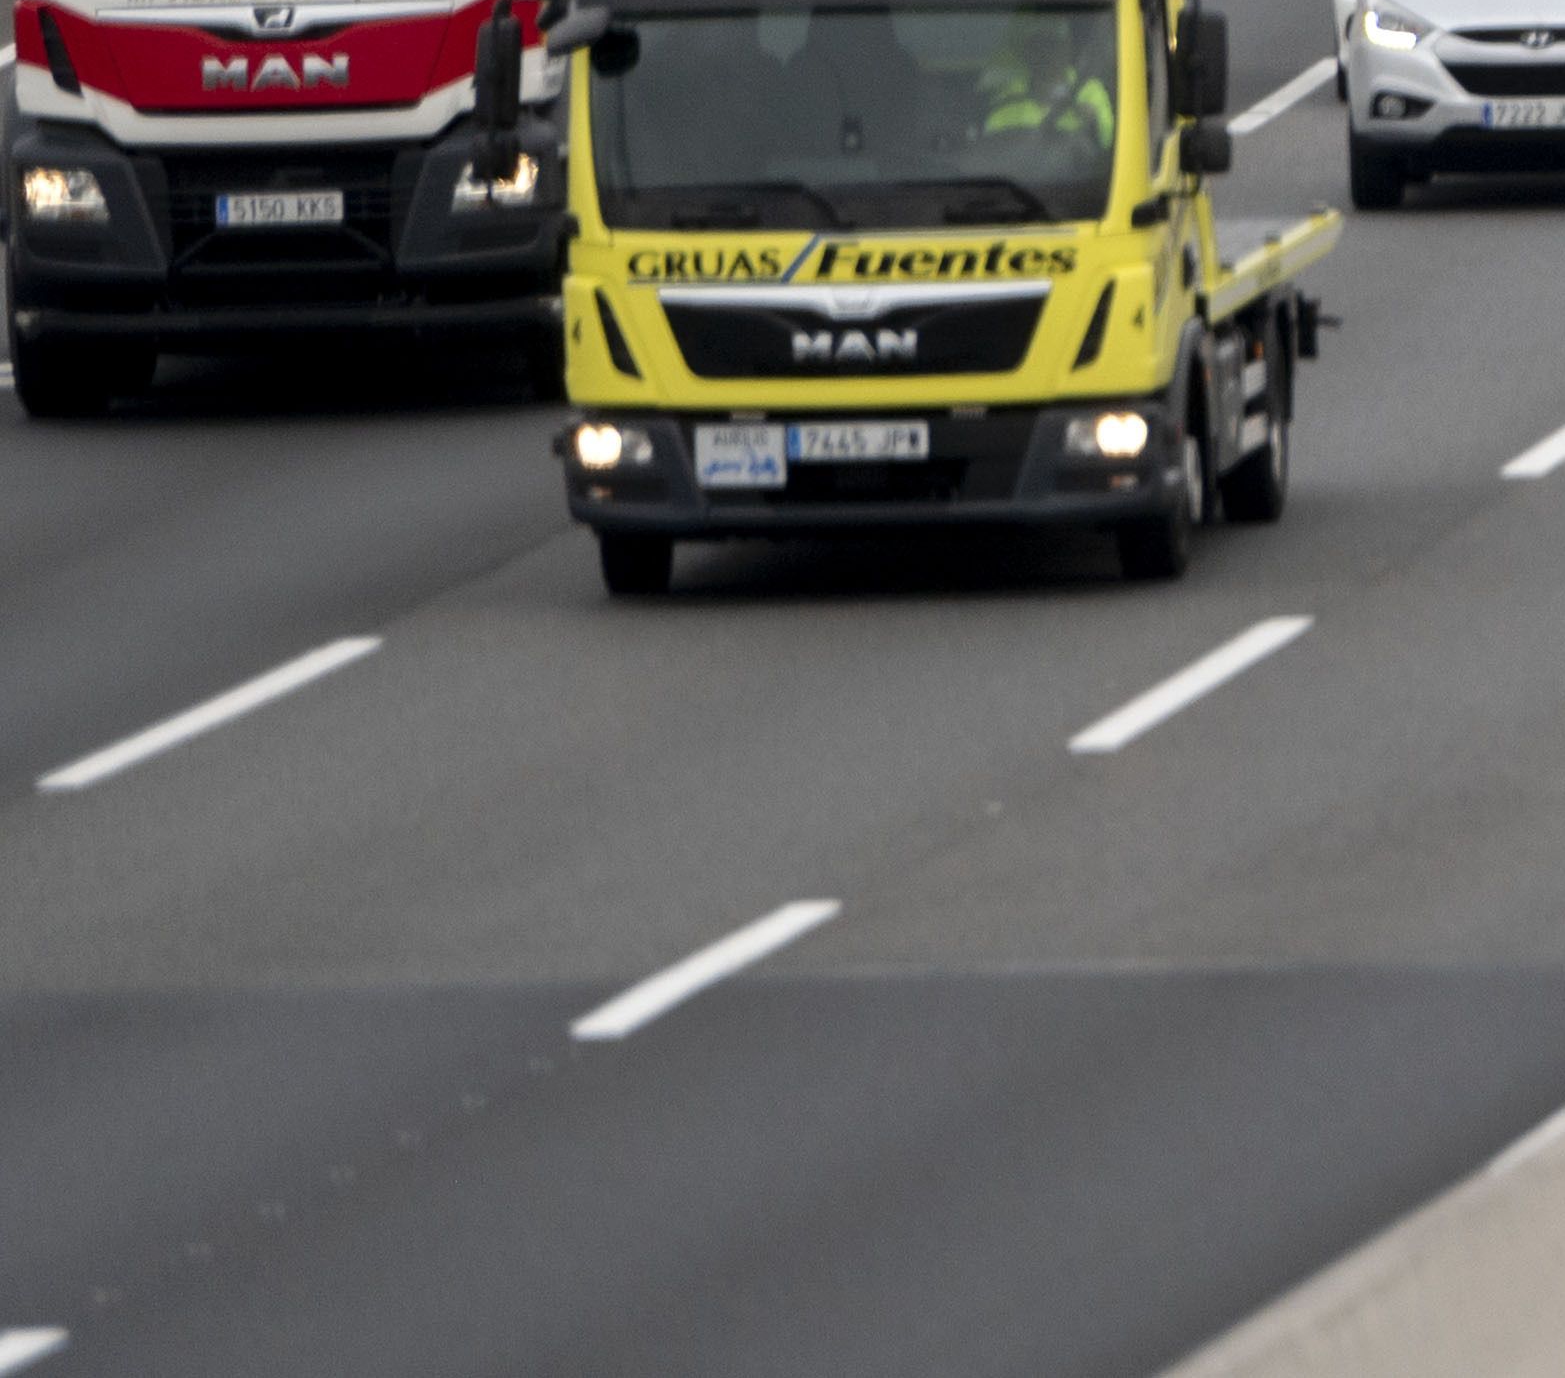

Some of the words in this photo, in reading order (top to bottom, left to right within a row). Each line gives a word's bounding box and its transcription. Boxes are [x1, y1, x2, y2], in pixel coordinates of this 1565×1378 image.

[201, 51, 350, 92] MAN
[627, 249, 781, 280] GRUAS
[814, 242, 1075, 280] Fuentes
[791, 329, 918, 361] MAN
